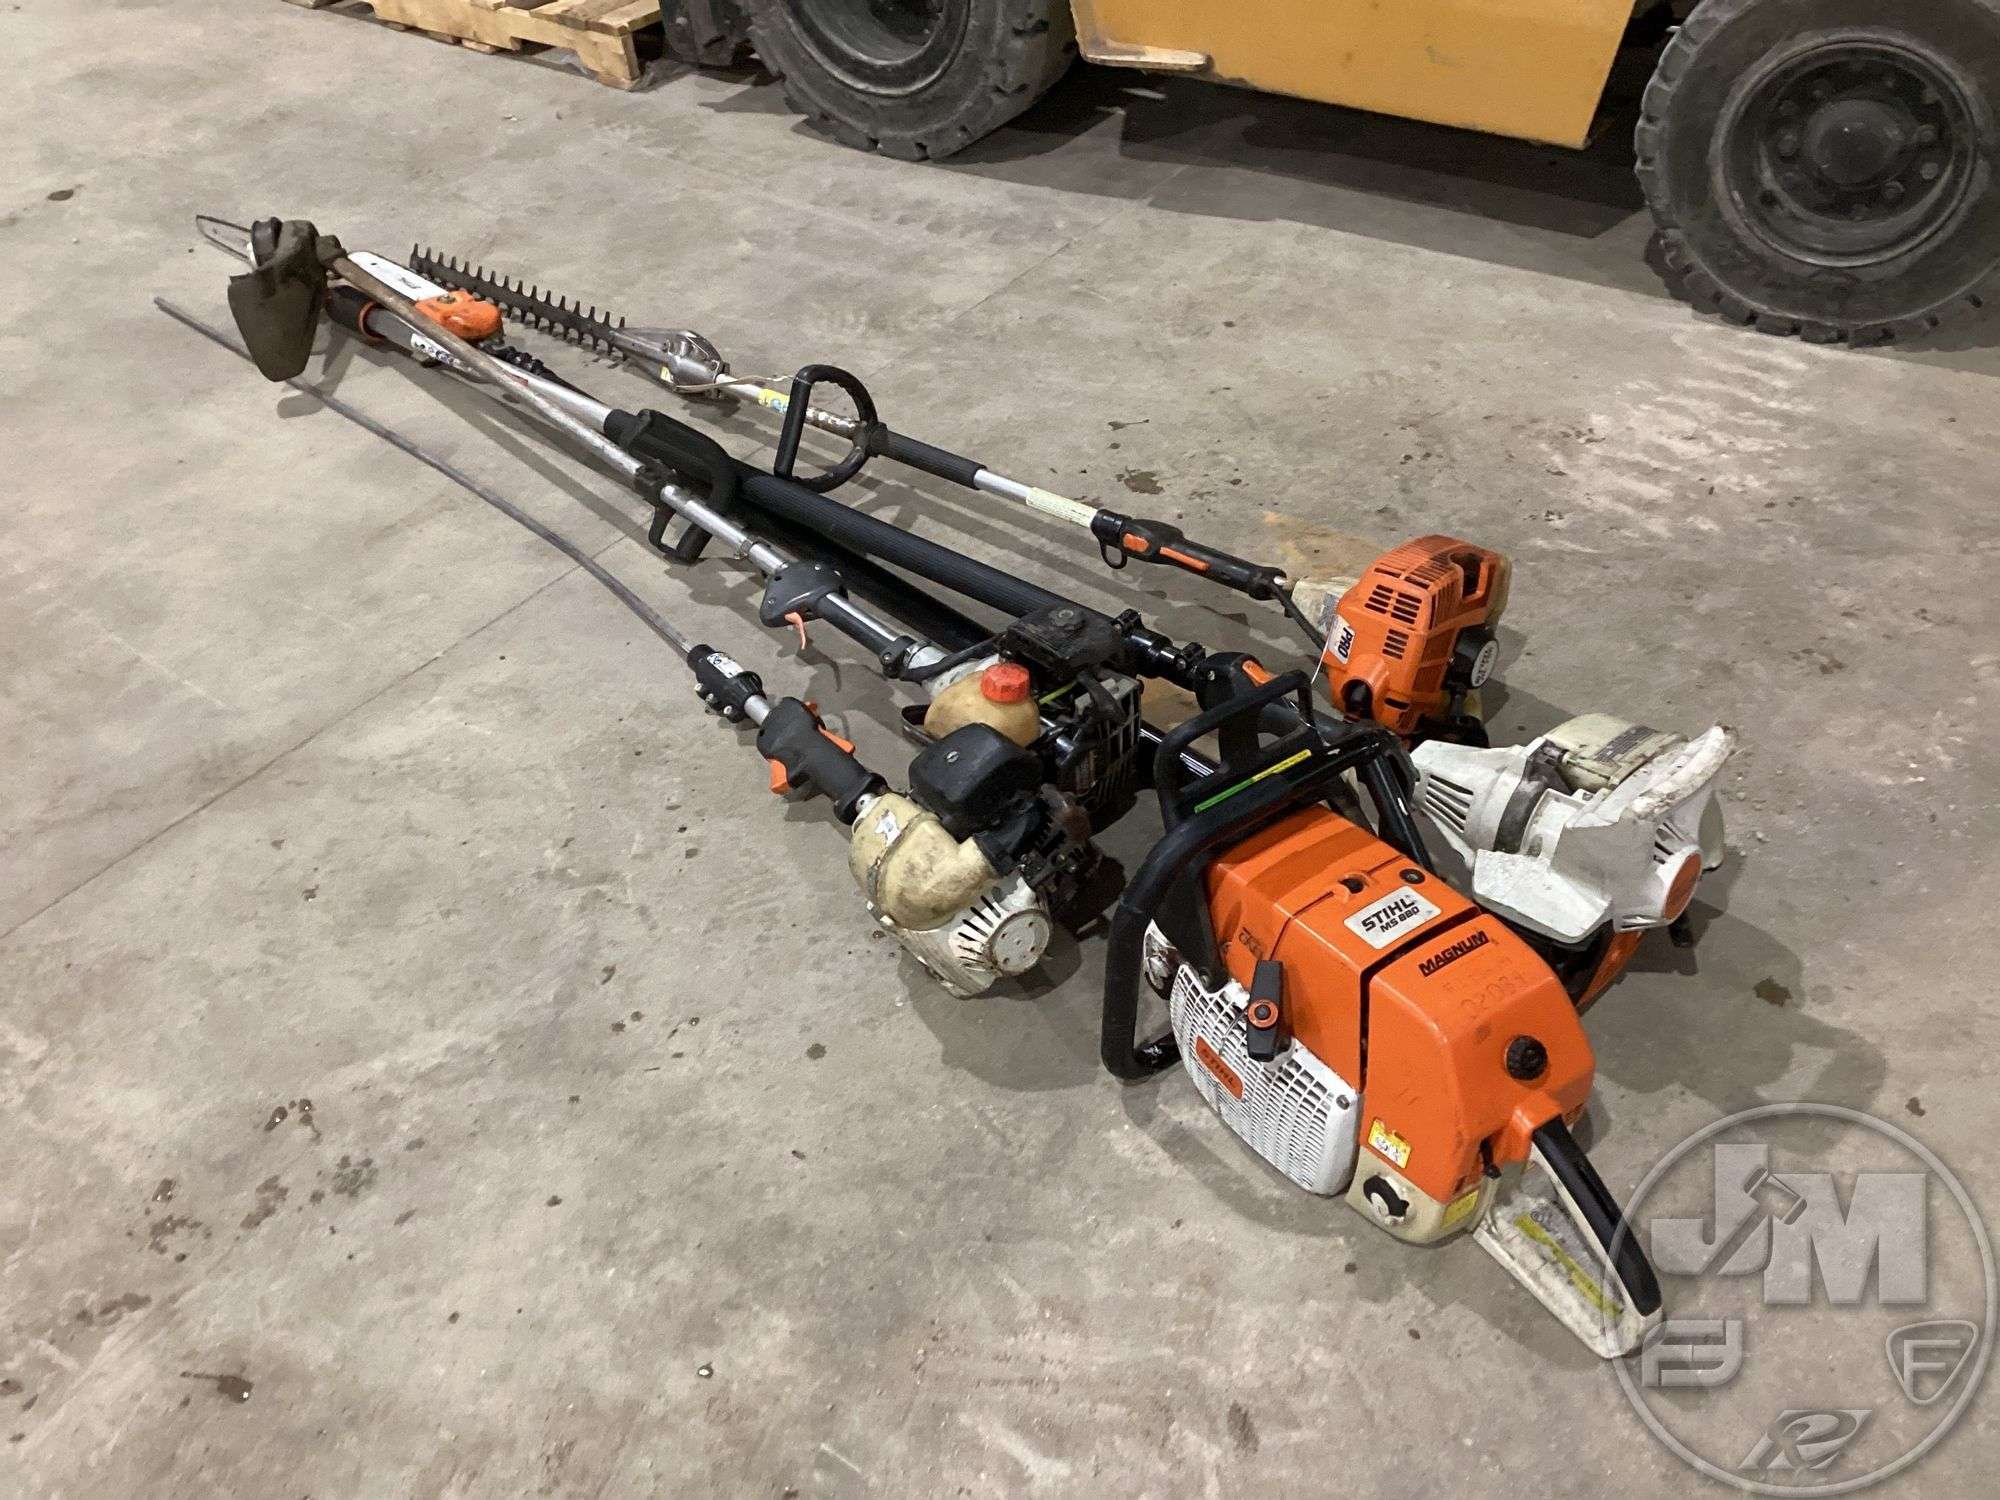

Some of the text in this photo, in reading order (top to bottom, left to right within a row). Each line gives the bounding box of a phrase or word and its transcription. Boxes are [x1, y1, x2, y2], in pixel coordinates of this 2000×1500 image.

[1337, 626, 1354, 659] PRO
[1360, 898, 1417, 932] STIHL
[1380, 918, 1399, 933] MS
[1418, 930, 1490, 978] MAGNUM
